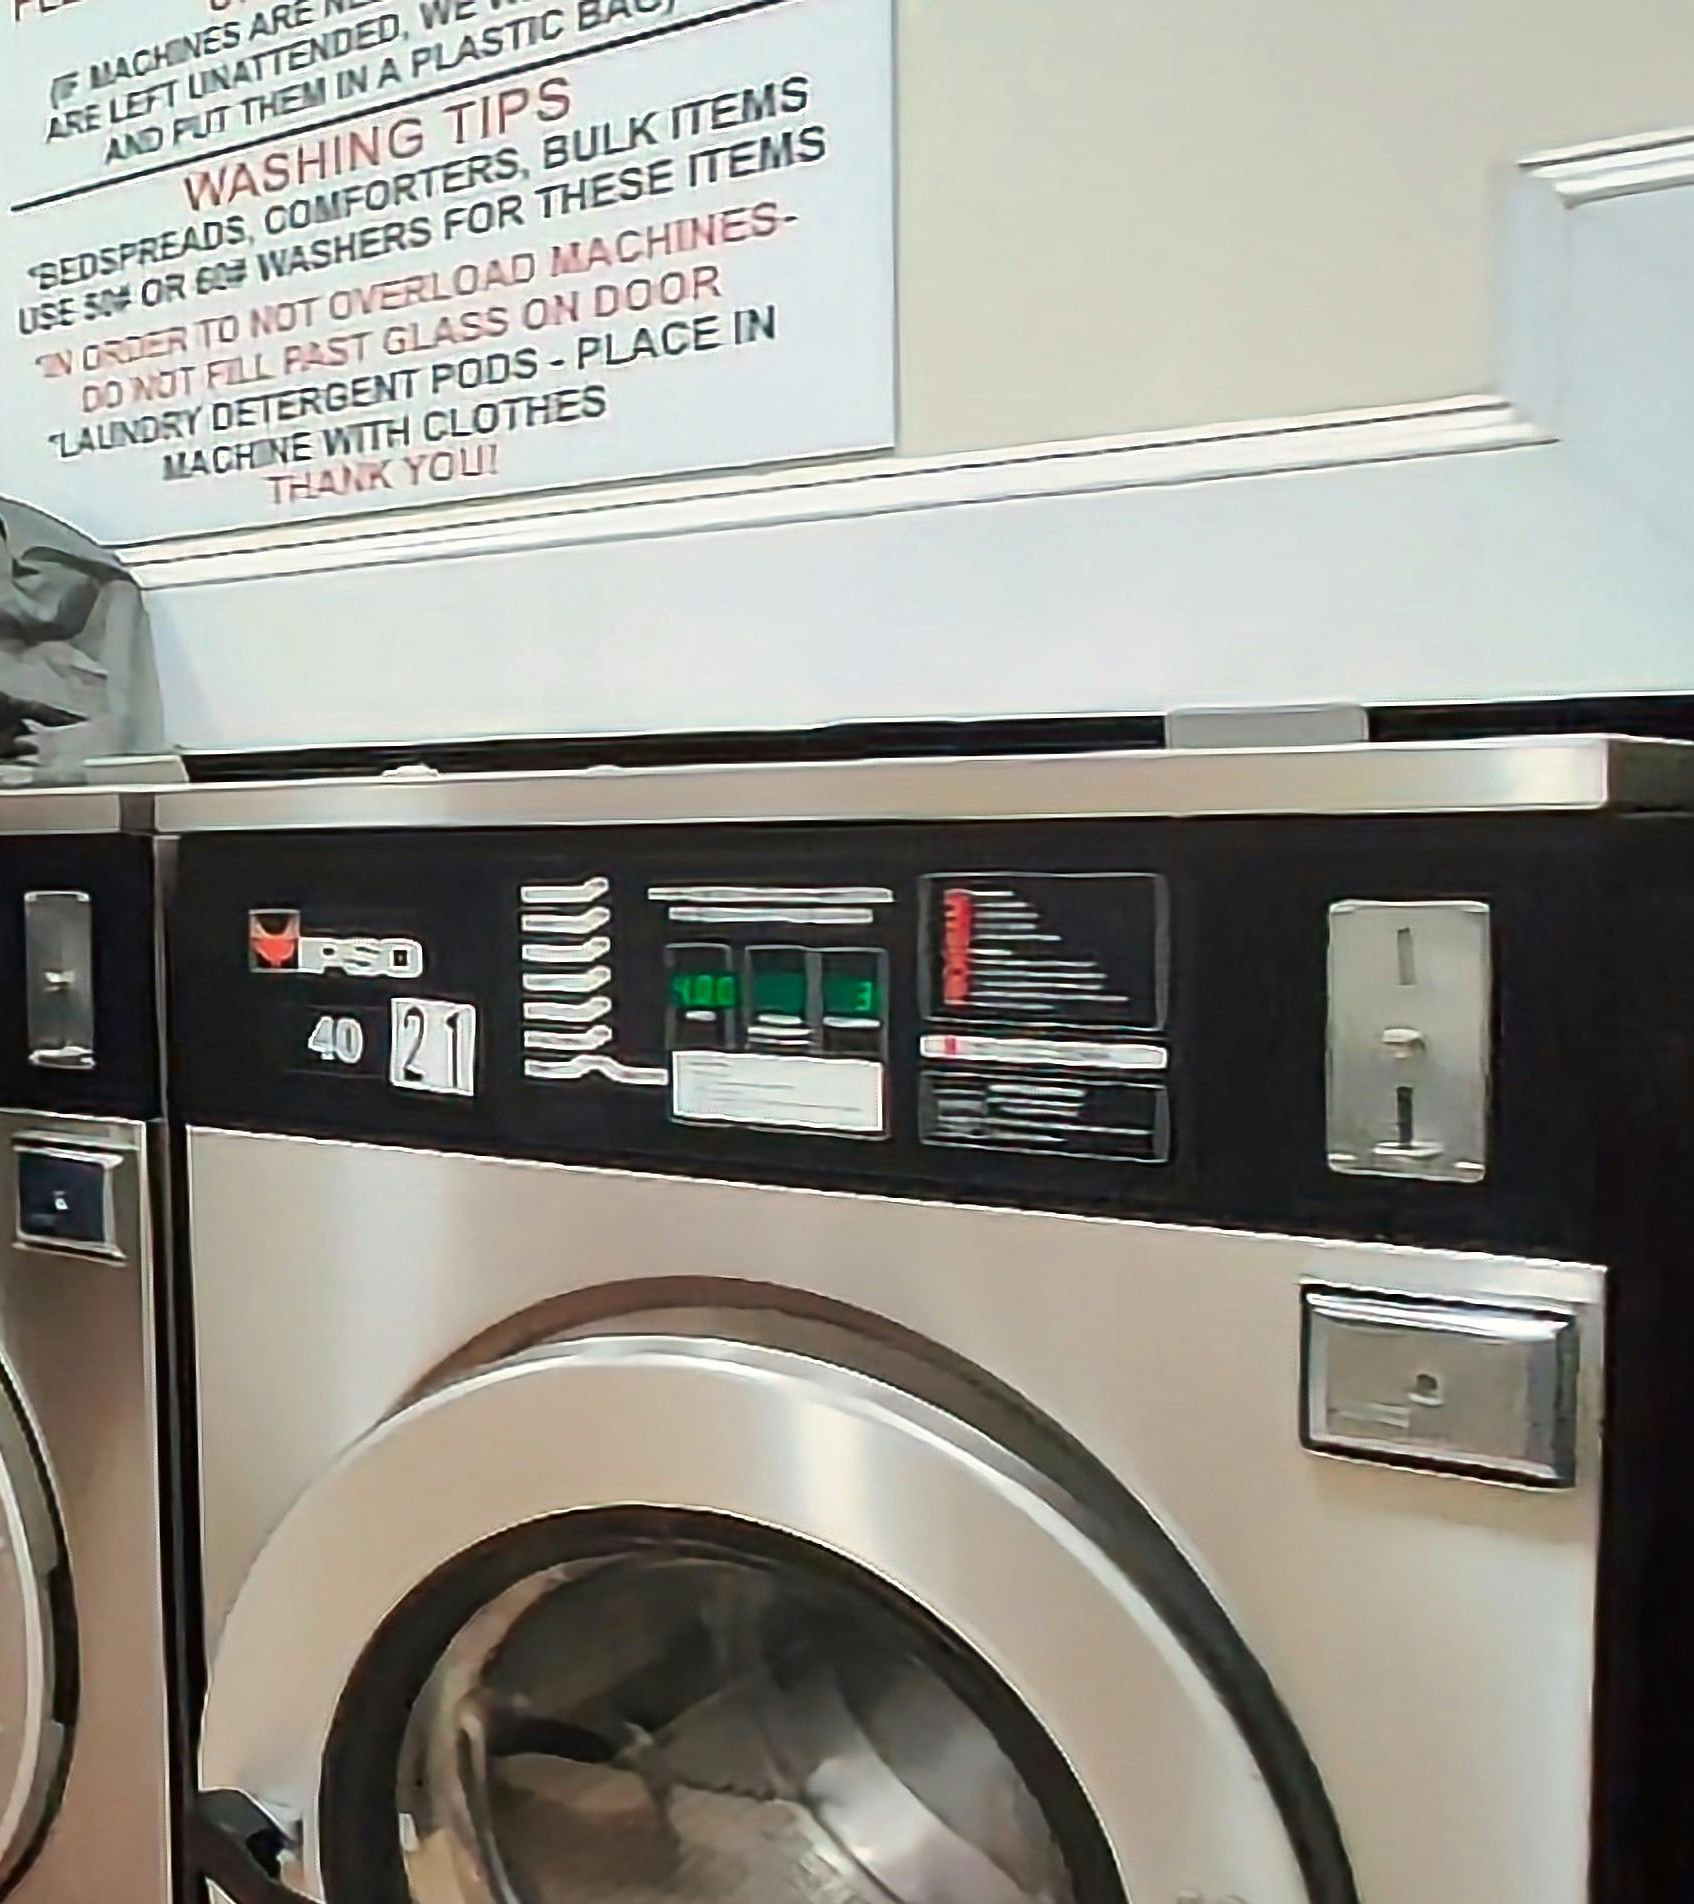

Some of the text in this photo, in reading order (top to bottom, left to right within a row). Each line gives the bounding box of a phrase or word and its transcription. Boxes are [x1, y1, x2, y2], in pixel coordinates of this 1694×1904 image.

[45, 104, 102, 144] ARE
[109, 79, 179, 124] LEFT
[188, 13, 409, 100] UNATTENDED,
[89, 22, 240, 88] MACHINES
[249, 0, 314, 41] ARE
[104, 127, 164, 165] AND
[172, 105, 231, 146] PUT
[238, 77, 326, 126] THEM
[336, 65, 368, 99] IN
[378, 57, 402, 90] A
[411, 10, 564, 79] PLASTIC
[183, 76, 572, 212] WASHING TIPS
[264, 147, 531, 235] COMFORTERS,
[542, 112, 659, 169] BULK
[672, 75, 810, 138] ITEMS
[18, 298, 74, 336] USE
[141, 273, 187, 307] OR
[257, 216, 433, 282] WASHERS
[443, 194, 523, 240] FOR
[534, 159, 675, 219] THESE
[688, 126, 826, 188] ITEMS
[82, 326, 188, 371] ORDER
[196, 314, 239, 349] TO
[249, 296, 322, 338] NOT
[328, 252, 536, 321] OVERLOAD
[82, 265, 722, 413] DO NOT FILL PAST GLASS ON DOOR
[212, 368, 423, 432] DETERGENT
[431, 347, 538, 394] PODS
[577, 315, 721, 370] PLACE
[734, 304, 778, 346] IN
[162, 384, 607, 481] MACHINE WITH CLOTHES
[263, 444, 499, 506] THANK YOU!
[308, 1015, 364, 1064] 40
[402, 1006, 460, 1089] 21
